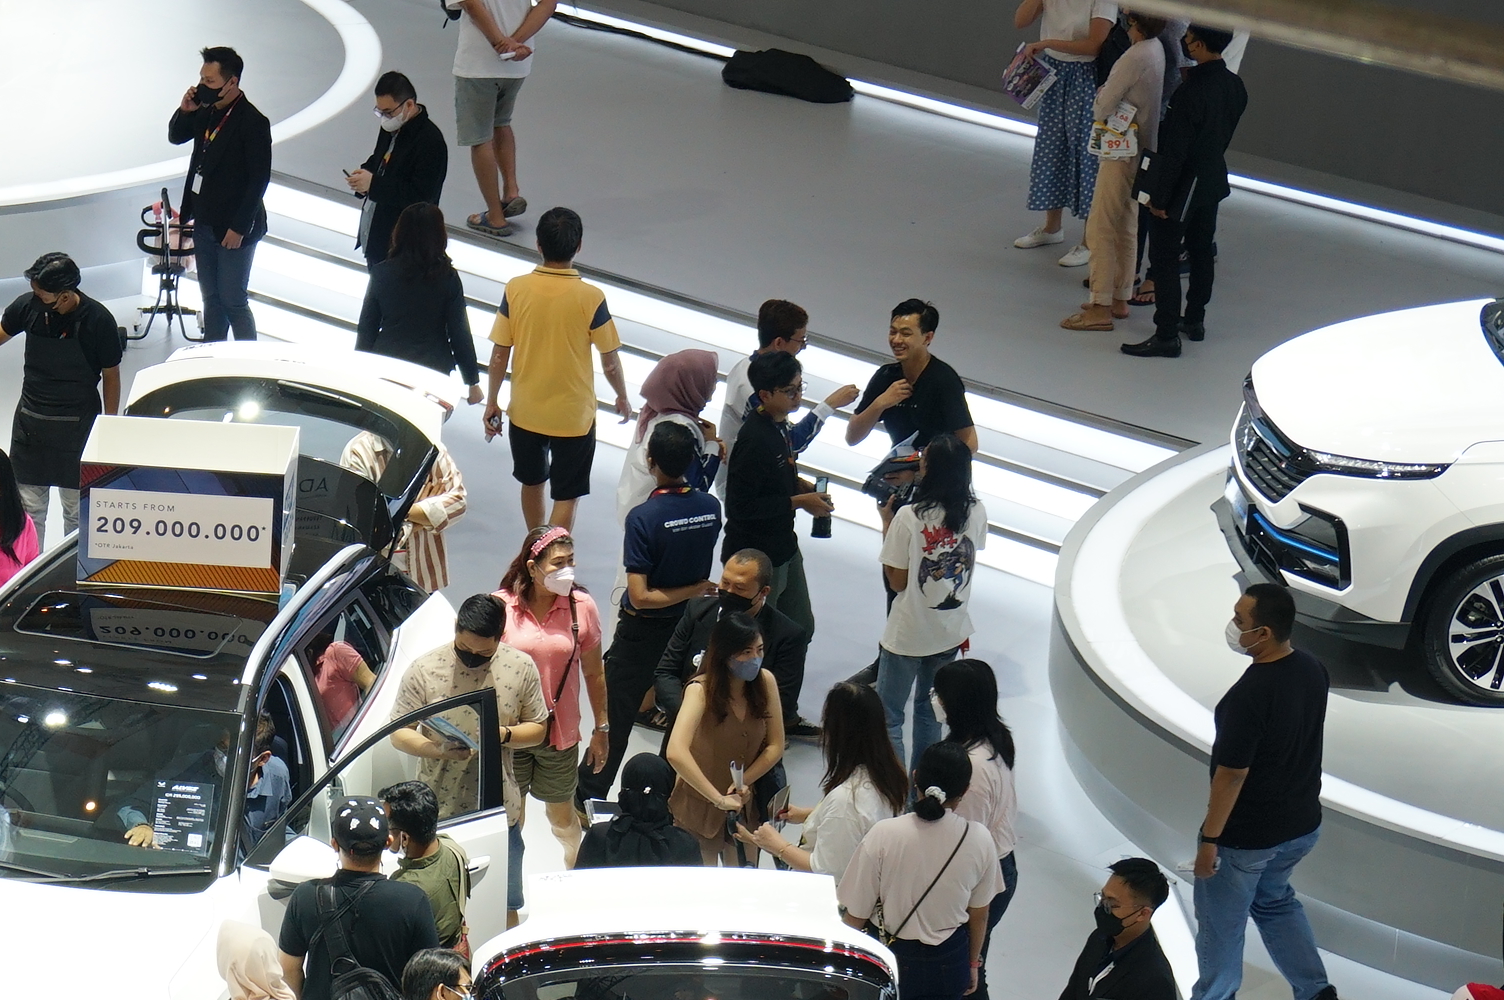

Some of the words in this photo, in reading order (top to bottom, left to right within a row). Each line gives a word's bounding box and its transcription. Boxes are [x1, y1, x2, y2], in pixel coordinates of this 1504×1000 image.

[96, 501, 137, 510] STARTS
[143, 503, 175, 512] FROM
[664, 518, 688, 528] CROWD
[689, 514, 716, 524] CONTROL
